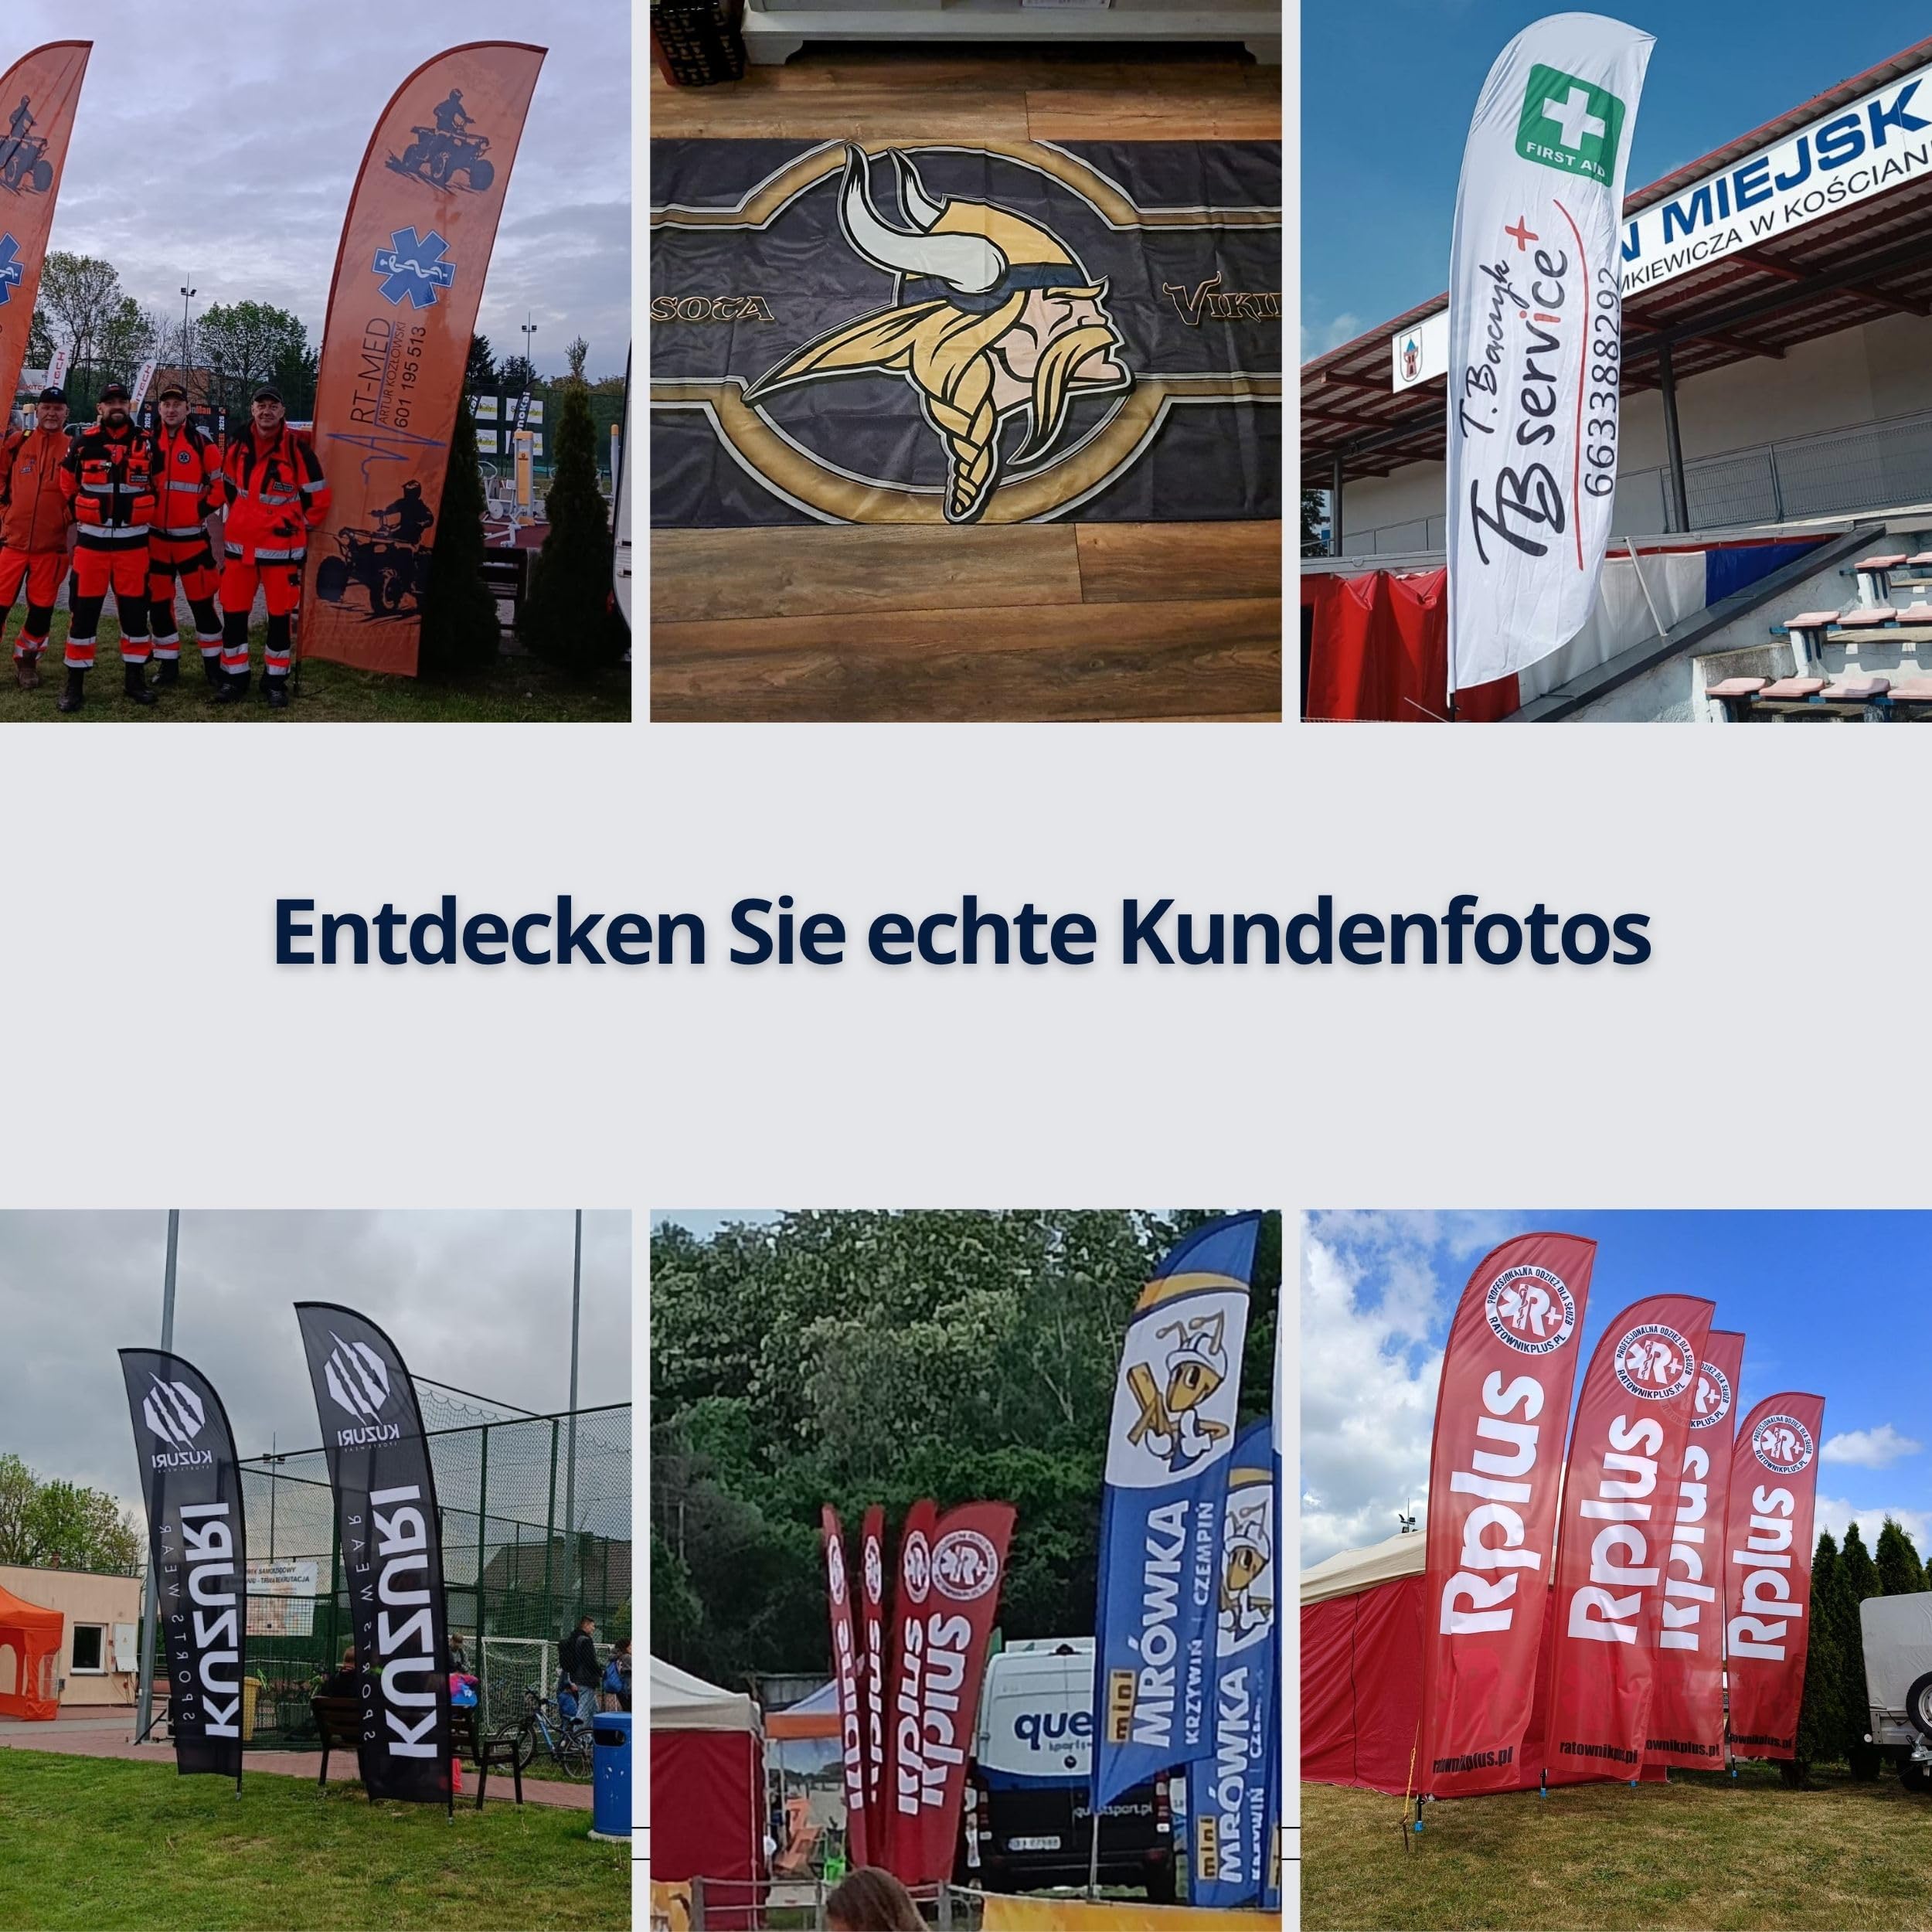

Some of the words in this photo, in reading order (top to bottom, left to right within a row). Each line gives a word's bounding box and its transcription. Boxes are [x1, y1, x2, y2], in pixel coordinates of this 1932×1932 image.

[1526, 141, 1577, 167] FIRST
[1580, 160, 1606, 178] AID
[1662, 78, 1931, 245] MIEJSK
[1749, 211, 1776, 236] W
[1784, 140, 1932, 223] KOŚCIAN
[349, 318, 391, 424] RT-MED
[378, 389, 393, 424] ARTUR
[386, 321, 406, 387] KOZŁOWSKI
[401, 362, 419, 389] 195
[407, 326, 427, 358] 513
[1516, 249, 1568, 446] service
[1584, 267, 1621, 498] 663388292
[393, 399, 412, 428] 601
[1487, 1267, 1533, 1304] PROFESJONALNA
[1535, 1268, 1560, 1288] ODZIEŻ
[1556, 1286, 1569, 1301] DLA
[1564, 1301, 1576, 1326] SŁUŻB
[1488, 1316, 1566, 1353] RATOWNIKPLUS.PL
[1616, 1325, 1658, 1359] PROFESJONALNA
[1660, 1326, 1682, 1344] ODZIEŻ
[1679, 1339, 1690, 1353] DLA
[1685, 1354, 1694, 1376] SŁUŻB
[1617, 1369, 1685, 1399] RATOWNIKPLUS.PL
[1714, 1371, 1726, 1383] DLA
[1720, 1384, 1730, 1404] SŁUŻB
[1755, 1449, 1808, 1474] RATOWNIKPLUS.PL
[1799, 1427, 1808, 1438] DLA
[1439, 1369, 1545, 1636] Rplus
[1567, 1413, 1665, 1645] Rplus
[1192, 1502, 1214, 1606] CZEMPIŃ
[1726, 1484, 1804, 1662] Rplus
[1128, 1499, 1189, 1748] MRÓWKA
[1111, 1672, 1133, 1741] mini
[1185, 1638, 1203, 1744] KRZYWIŃ
[1208, 1666, 1250, 1883] MRÓWKA
[1200, 1818, 1216, 1878] mini
